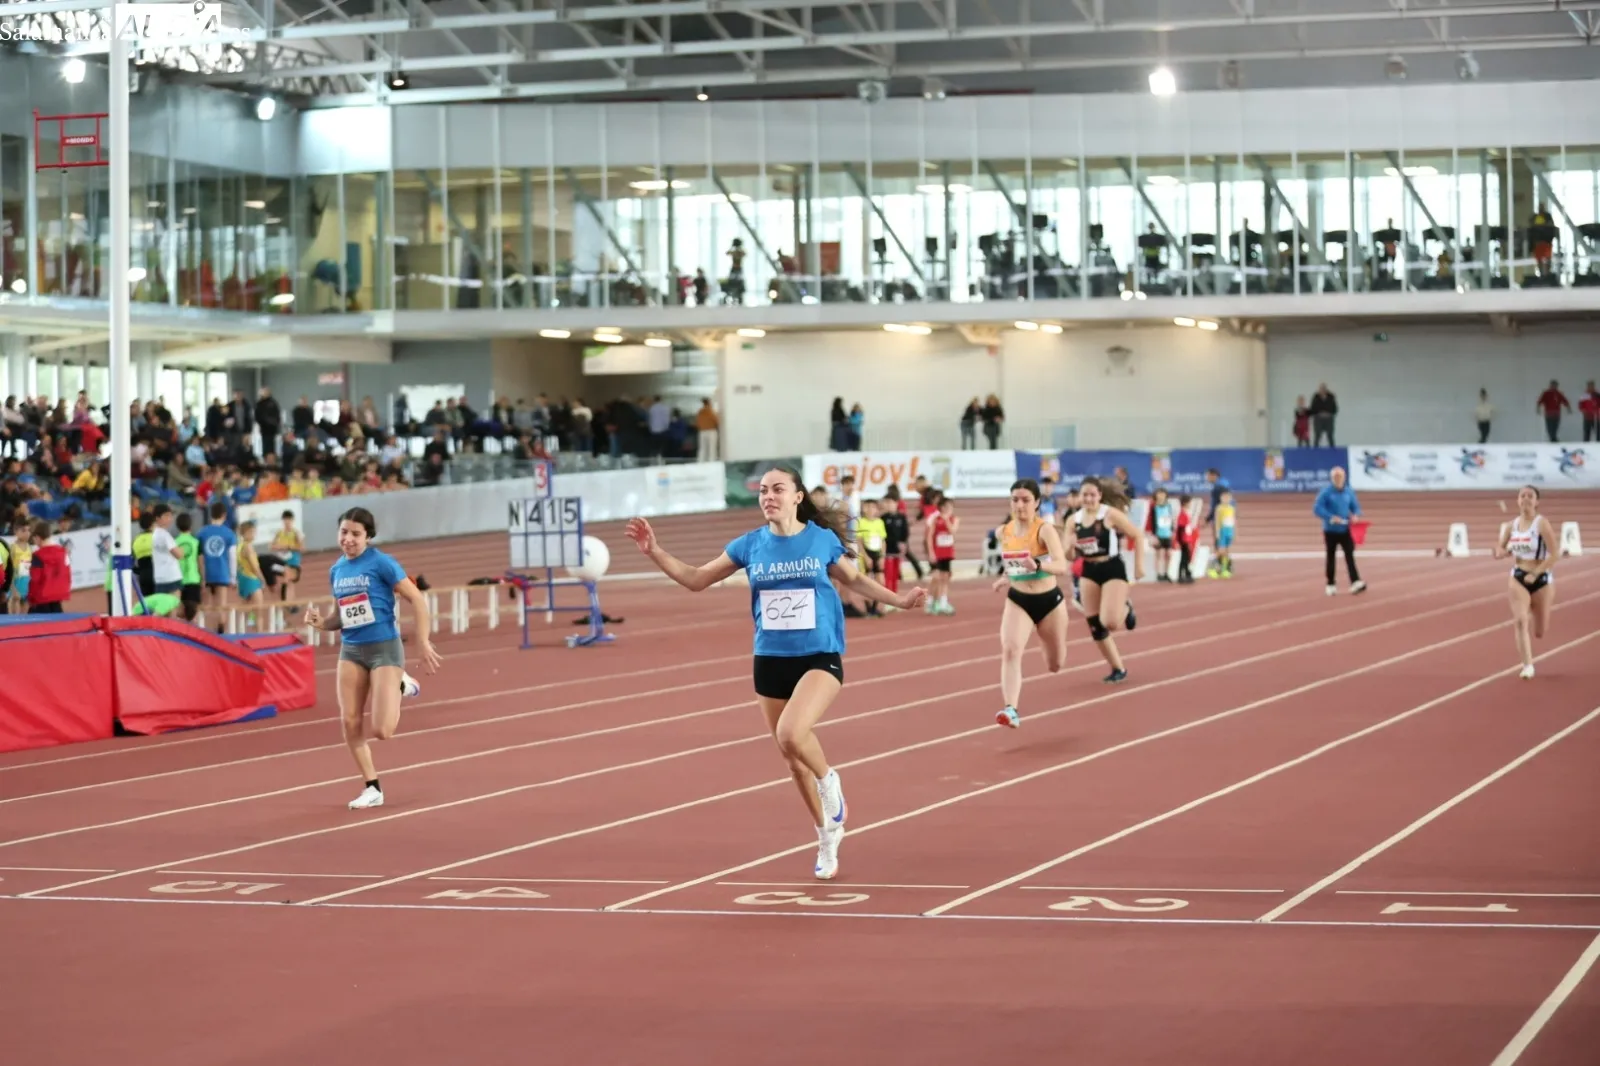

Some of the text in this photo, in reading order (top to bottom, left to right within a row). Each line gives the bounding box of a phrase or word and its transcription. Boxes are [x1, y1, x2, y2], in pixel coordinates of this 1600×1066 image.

[536, 463, 547, 489] 3
[752, 557, 821, 575] LA ARMUÑA
[776, 571, 818, 580] DEPORTIVO
[345, 604, 367, 618] 626
[765, 592, 809, 621] 624
[148, 880, 286, 895] 5
[420, 886, 551, 900] 4
[732, 891, 870, 906] 3
[1047, 895, 1190, 912] 2
[1379, 902, 1519, 914] 1
